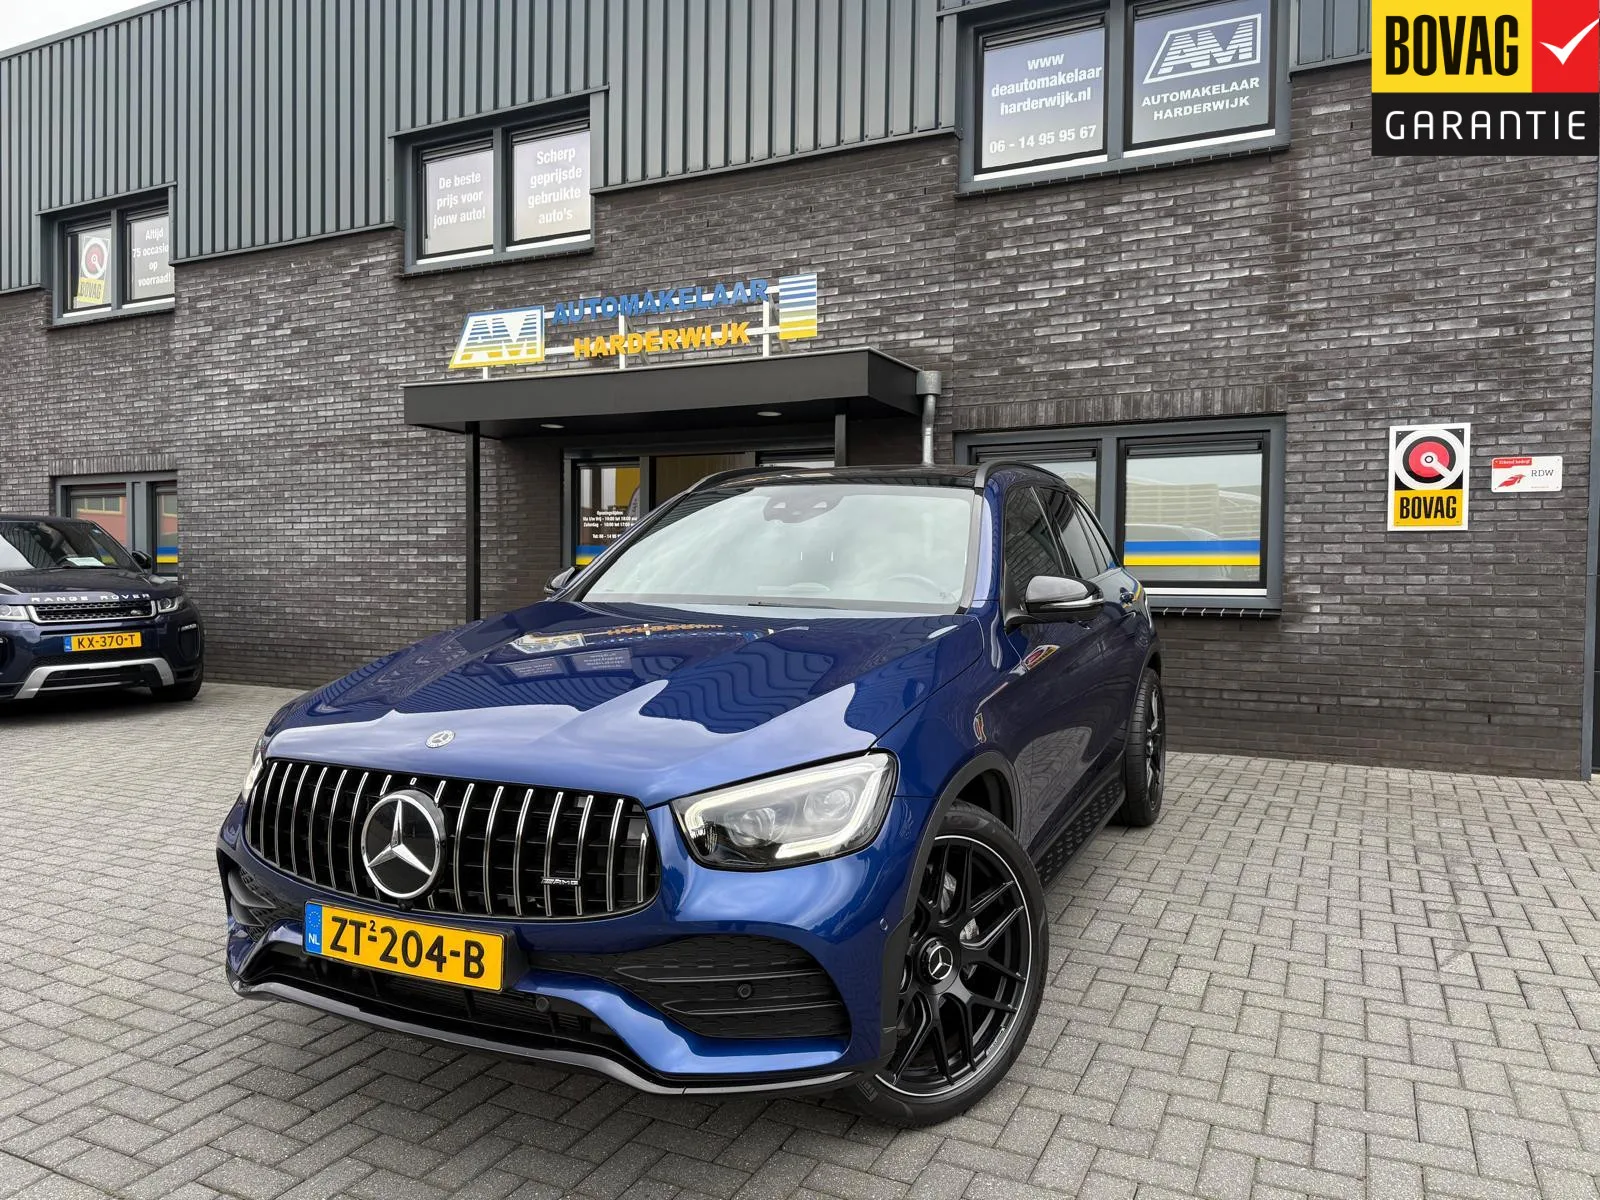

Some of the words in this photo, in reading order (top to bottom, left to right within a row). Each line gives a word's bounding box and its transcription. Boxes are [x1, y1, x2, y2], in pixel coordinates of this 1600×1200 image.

[1027, 53, 1065, 71] www
[991, 66, 1102, 98] deautomakelaar
[1000, 87, 1092, 116] harderwijk.nl
[1141, 77, 1261, 107] AUTOMAKELAAR
[1153, 96, 1251, 121] HARDERWIJK
[989, 139, 1006, 154] 06
[1018, 135, 1035, 149] 14
[1038, 131, 1055, 146] 95
[1058, 128, 1076, 143] 95
[1079, 125, 1097, 140] 67
[536, 147, 576, 165] Scherp
[439, 177, 452, 190] De
[454, 171, 481, 187] beste
[530, 166, 582, 188] geprijsde
[436, 194, 459, 210] prijs
[461, 190, 484, 204] voor
[528, 186, 581, 208] gebruikte
[433, 210, 458, 229] jouw
[460, 207, 486, 222] auto!
[538, 208, 574, 225] auto's
[145, 227, 164, 241] Altijd
[132, 247, 141, 258] 75
[149, 261, 158, 272] op
[138, 271, 171, 287] voorraad!
[79, 281, 102, 300] BOVAG
[551, 278, 769, 326] AUTOMAKELAAR
[573, 321, 750, 359] HARDERWIJK
[1531, 469, 1554, 477] RDW
[1399, 495, 1457, 520] BOVAG
[77, 634, 136, 649] KX-370-T
[308, 933, 320, 946] NL
